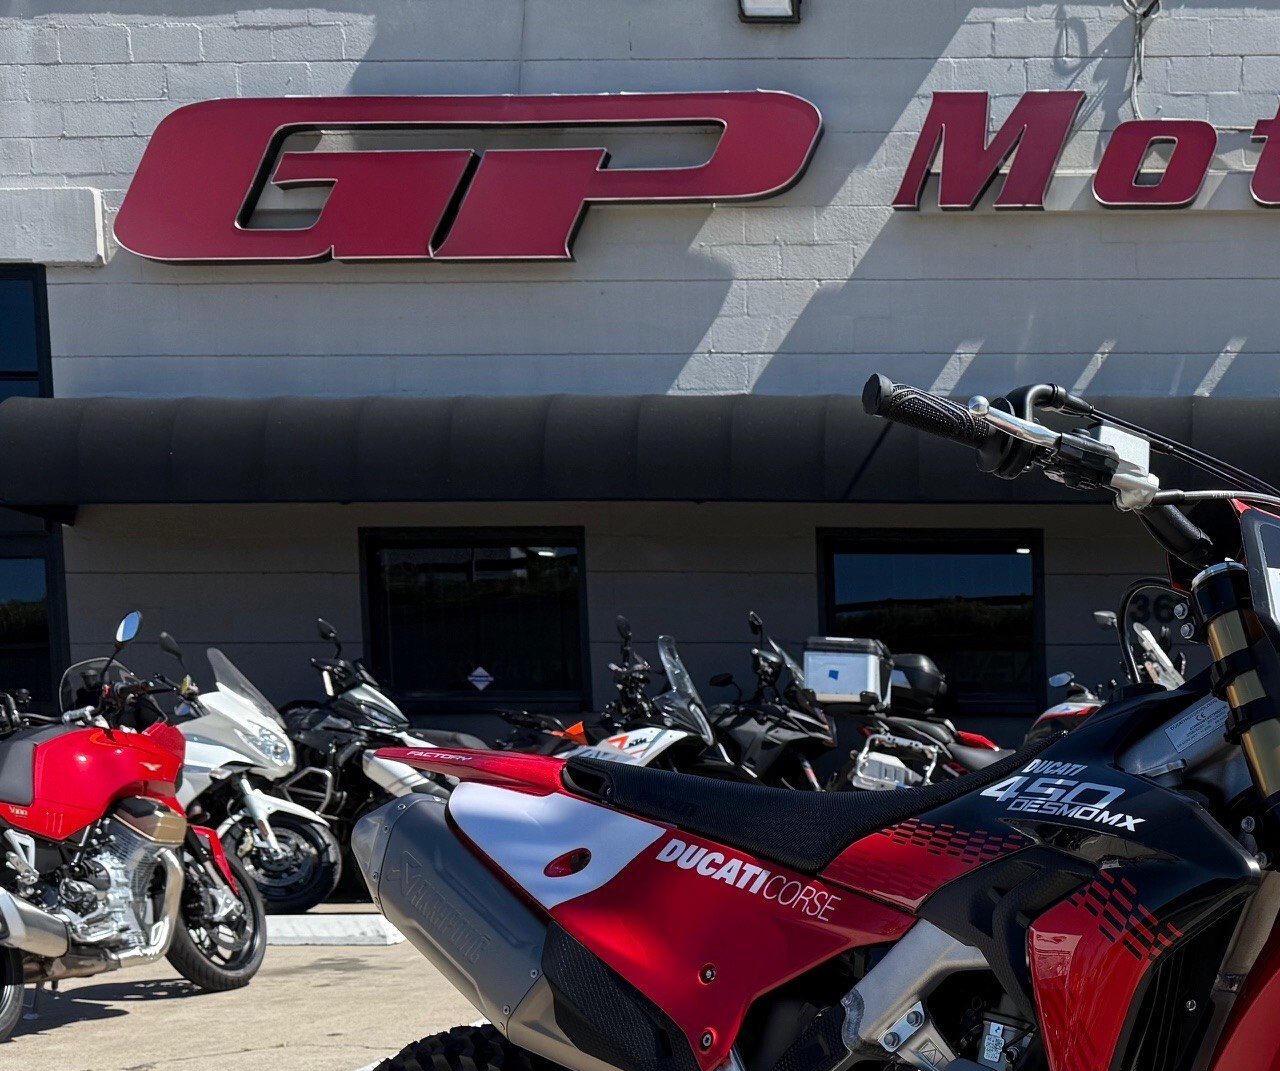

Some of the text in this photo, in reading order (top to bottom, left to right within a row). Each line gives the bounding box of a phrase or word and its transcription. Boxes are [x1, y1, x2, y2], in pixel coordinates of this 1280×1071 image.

[114, 90, 823, 264] GP
[628, 737, 647, 748] KTM
[406, 750, 473, 763] FACTORY
[1021, 758, 1088, 777] DUCATI
[979, 775, 1126, 810] 450
[655, 838, 842, 922] DUCATI CORSE
